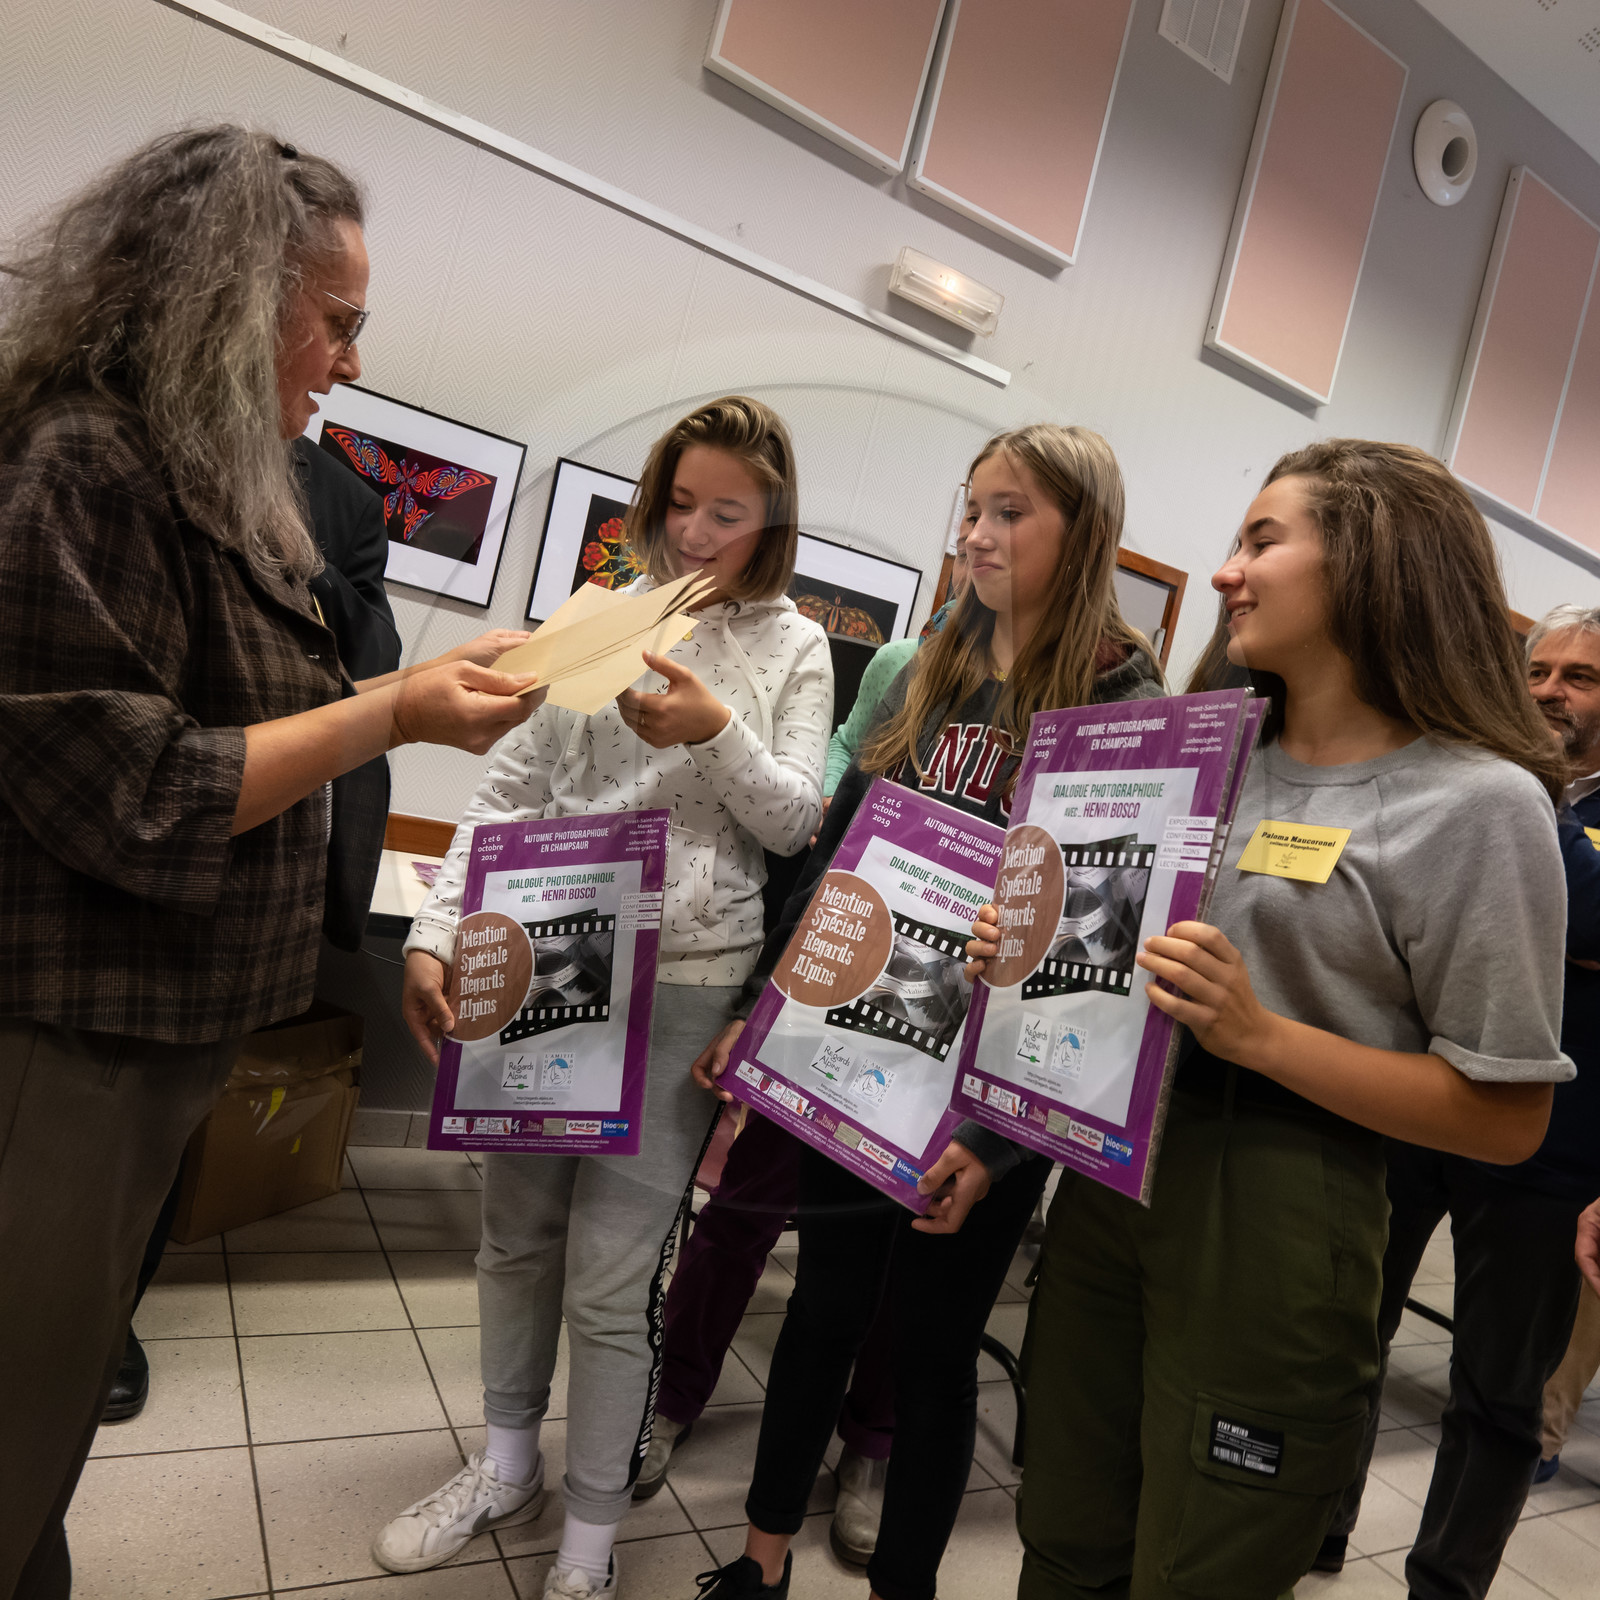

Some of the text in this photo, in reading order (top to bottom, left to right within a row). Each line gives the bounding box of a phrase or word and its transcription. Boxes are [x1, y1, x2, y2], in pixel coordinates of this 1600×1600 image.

[1038, 724, 1056, 736] 5 et 6
[1076, 718, 1167, 736] AUTOMNE PHOTOGRAPHIQUE
[1032, 737, 1057, 747] octobre
[1090, 736, 1142, 750] EN CHAMPSAUR
[1034, 750, 1050, 760] 2019
[1053, 782, 1166, 798] DIALOGUE PHOTOGRAPHIQUE
[872, 802, 902, 820] octobre
[886, 798, 896, 806] et
[896, 800, 902, 808] 6
[1083, 802, 1110, 818] HENRI
[1110, 802, 1140, 818] BOSCO
[872, 814, 891, 828] 2019
[924, 817, 959, 838] AUTOMNE
[1168, 818, 1208, 826] EXPOSITIONS
[524, 828, 610, 844] AUTOMNE PHOTOGRAPHIQUE
[1262, 832, 1290, 842] Paloma
[478, 844, 504, 853] octobre
[540, 840, 589, 853] EN CHAMPSAUR
[938, 836, 994, 868] EN CHAMPSAUR
[1163, 847, 1200, 856] ANIMATIONS
[481, 854, 498, 862] 2019
[1004, 843, 1046, 869] Mention
[1160, 860, 1189, 868] LECTURES
[889, 856, 932, 883] DIALOGUE
[507, 872, 616, 890] DIALOGUE PHOTOGRAPHIQUE
[1000, 871, 1042, 903] Spéciale
[542, 888, 567, 902] HENRI
[568, 886, 596, 900] BOSCO
[820, 884, 874, 918] Mention
[920, 888, 952, 910] HENRI
[812, 908, 867, 942] Spéciale
[461, 926, 508, 950] Mention
[801, 930, 855, 966] Regards
[996, 933, 1024, 962] lpins
[460, 946, 508, 976] Spéciale
[792, 954, 836, 986] Alpins
[460, 970, 506, 996] Regards
[458, 998, 498, 1022] Alpins
[1025, 1024, 1048, 1042] Regards
[818, 1056, 840, 1072] Alpins
[824, 1046, 851, 1066] Regards
[508, 1062, 534, 1074] Regards
[602, 1120, 628, 1131] biocoop
[1106, 1136, 1132, 1158] biocoop
